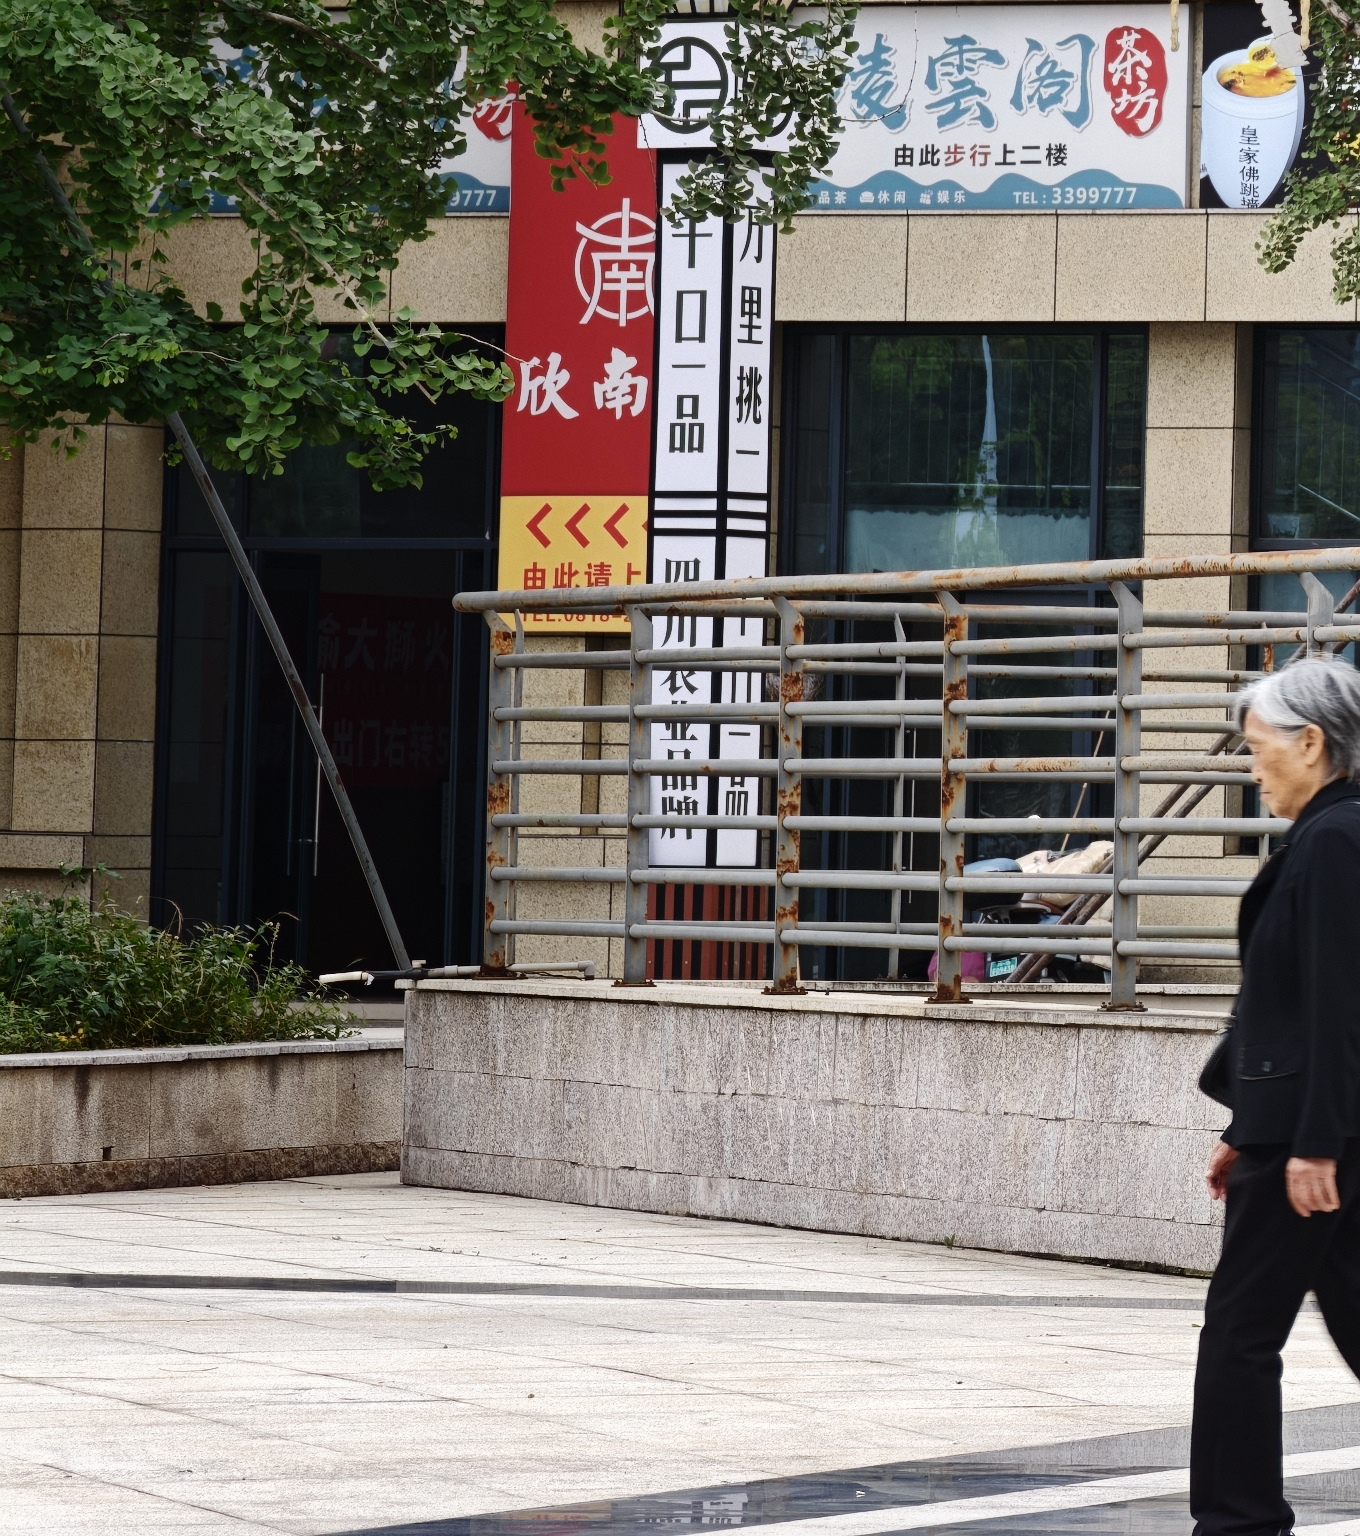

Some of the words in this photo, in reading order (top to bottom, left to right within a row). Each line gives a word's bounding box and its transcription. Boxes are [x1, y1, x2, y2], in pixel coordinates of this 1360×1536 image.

[1108, 30, 1163, 132] 茶坊
[893, 143, 1069, 168] 由此步行上二楼
[1238, 124, 1261, 208] 皇家佛跳墙
[817, 190, 848, 204] 品茶
[876, 190, 907, 204] 休闲
[936, 190, 967, 204] 娱乐
[1050, 186, 1138, 205] 3399777
[516, 346, 648, 420] 欣南
